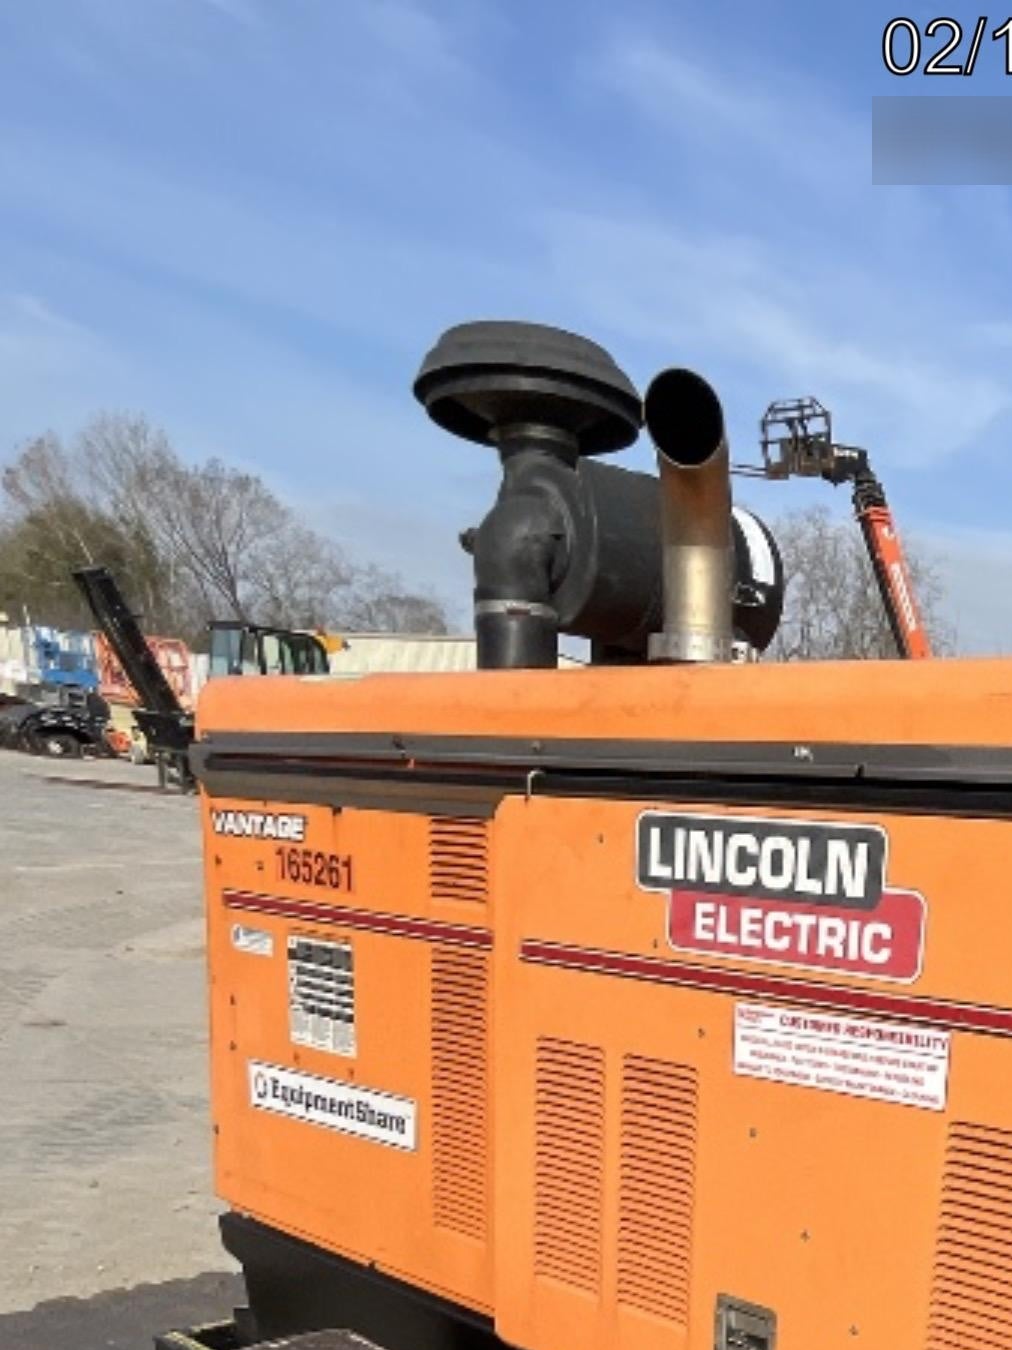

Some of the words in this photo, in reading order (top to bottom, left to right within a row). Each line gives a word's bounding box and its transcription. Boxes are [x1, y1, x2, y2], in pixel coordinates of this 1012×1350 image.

[212, 810, 306, 842] VANTAGE
[275, 847, 352, 892] 165261
[649, 827, 869, 898] LINCOLN
[693, 901, 893, 963] ELECTRIC
[269, 1076, 407, 1136] EquipmentShare
